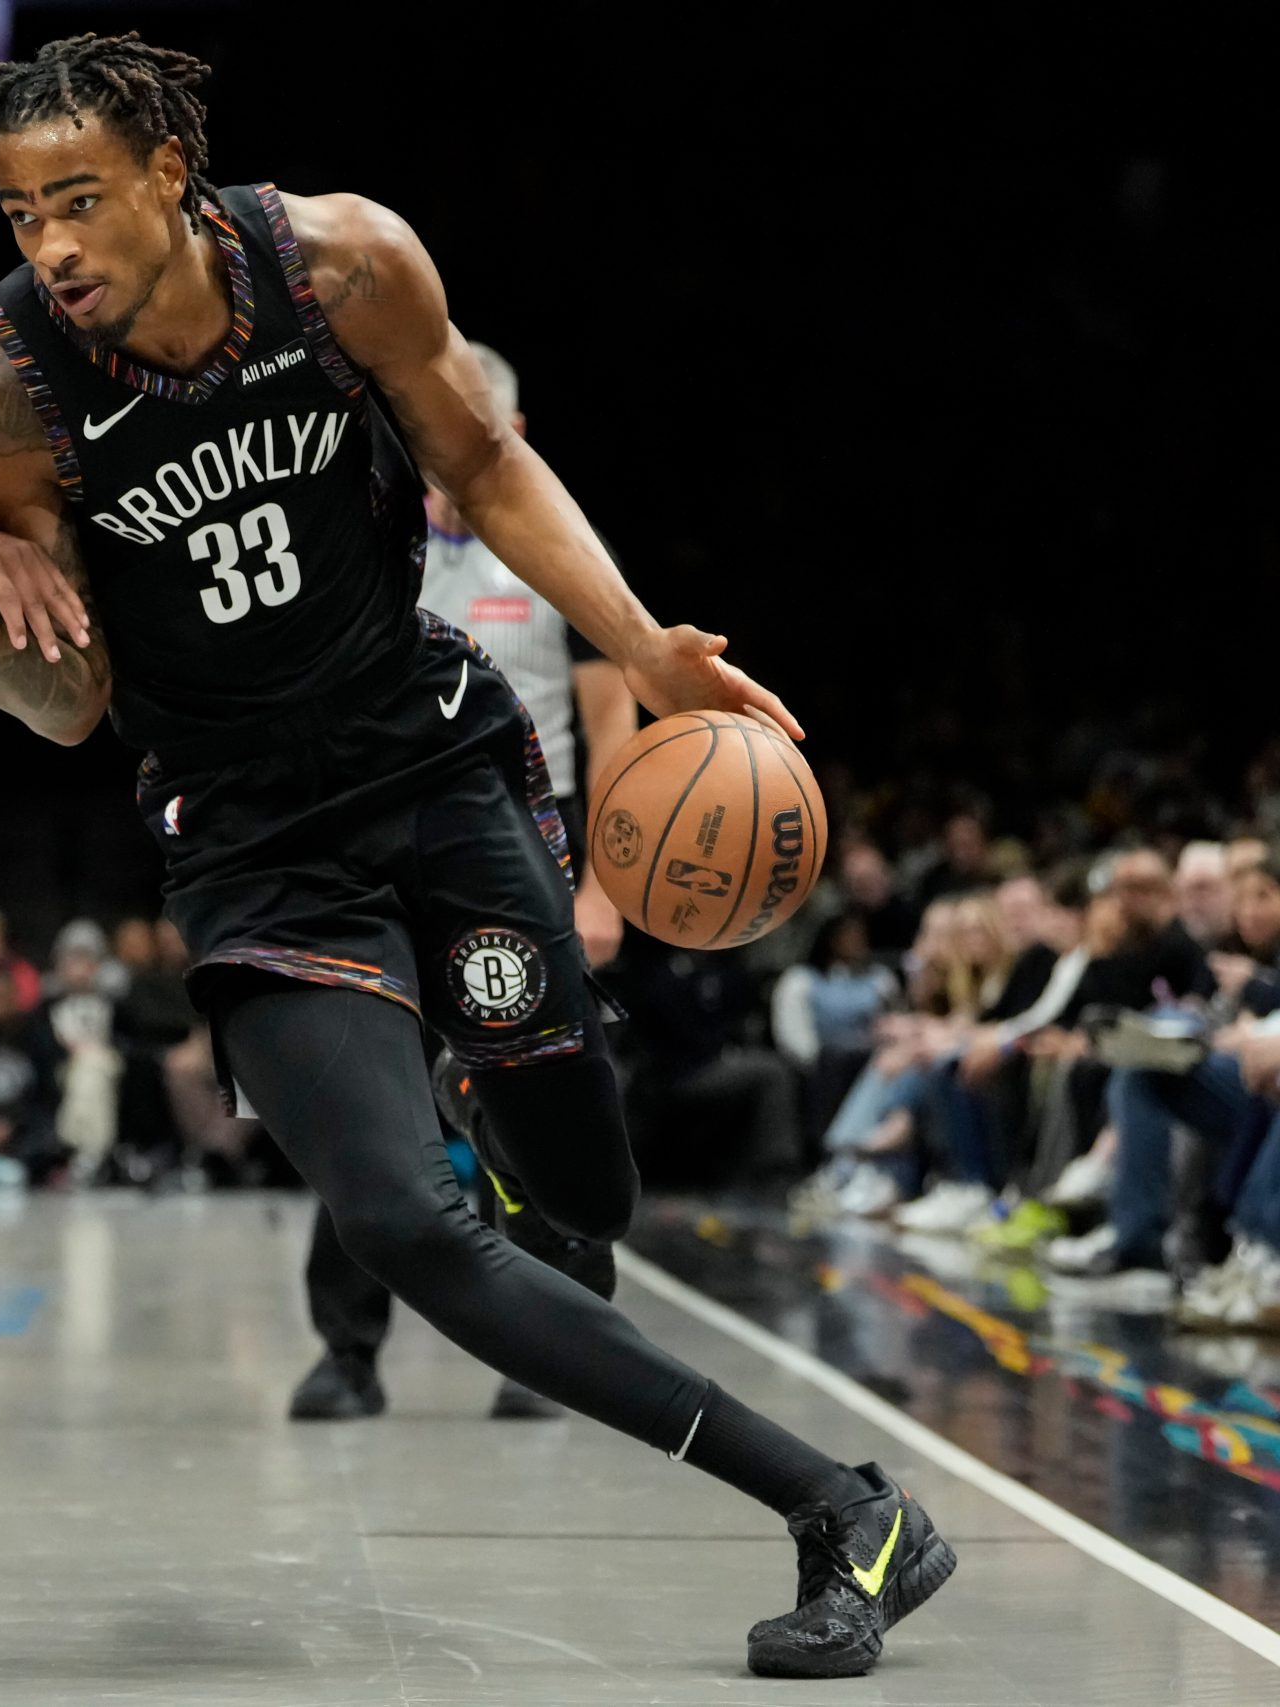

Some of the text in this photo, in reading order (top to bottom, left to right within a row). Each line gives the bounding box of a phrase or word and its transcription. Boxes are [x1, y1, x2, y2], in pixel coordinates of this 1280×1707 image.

[241, 348, 306, 386] All In Won
[90, 411, 350, 545] BROOKLYN
[186, 502, 302, 624] 33
[729, 803, 804, 944] Wilson
[454, 935, 533, 967] BROOKLYN
[483, 956, 507, 1001] B
[463, 991, 535, 1020] NEW YORK
